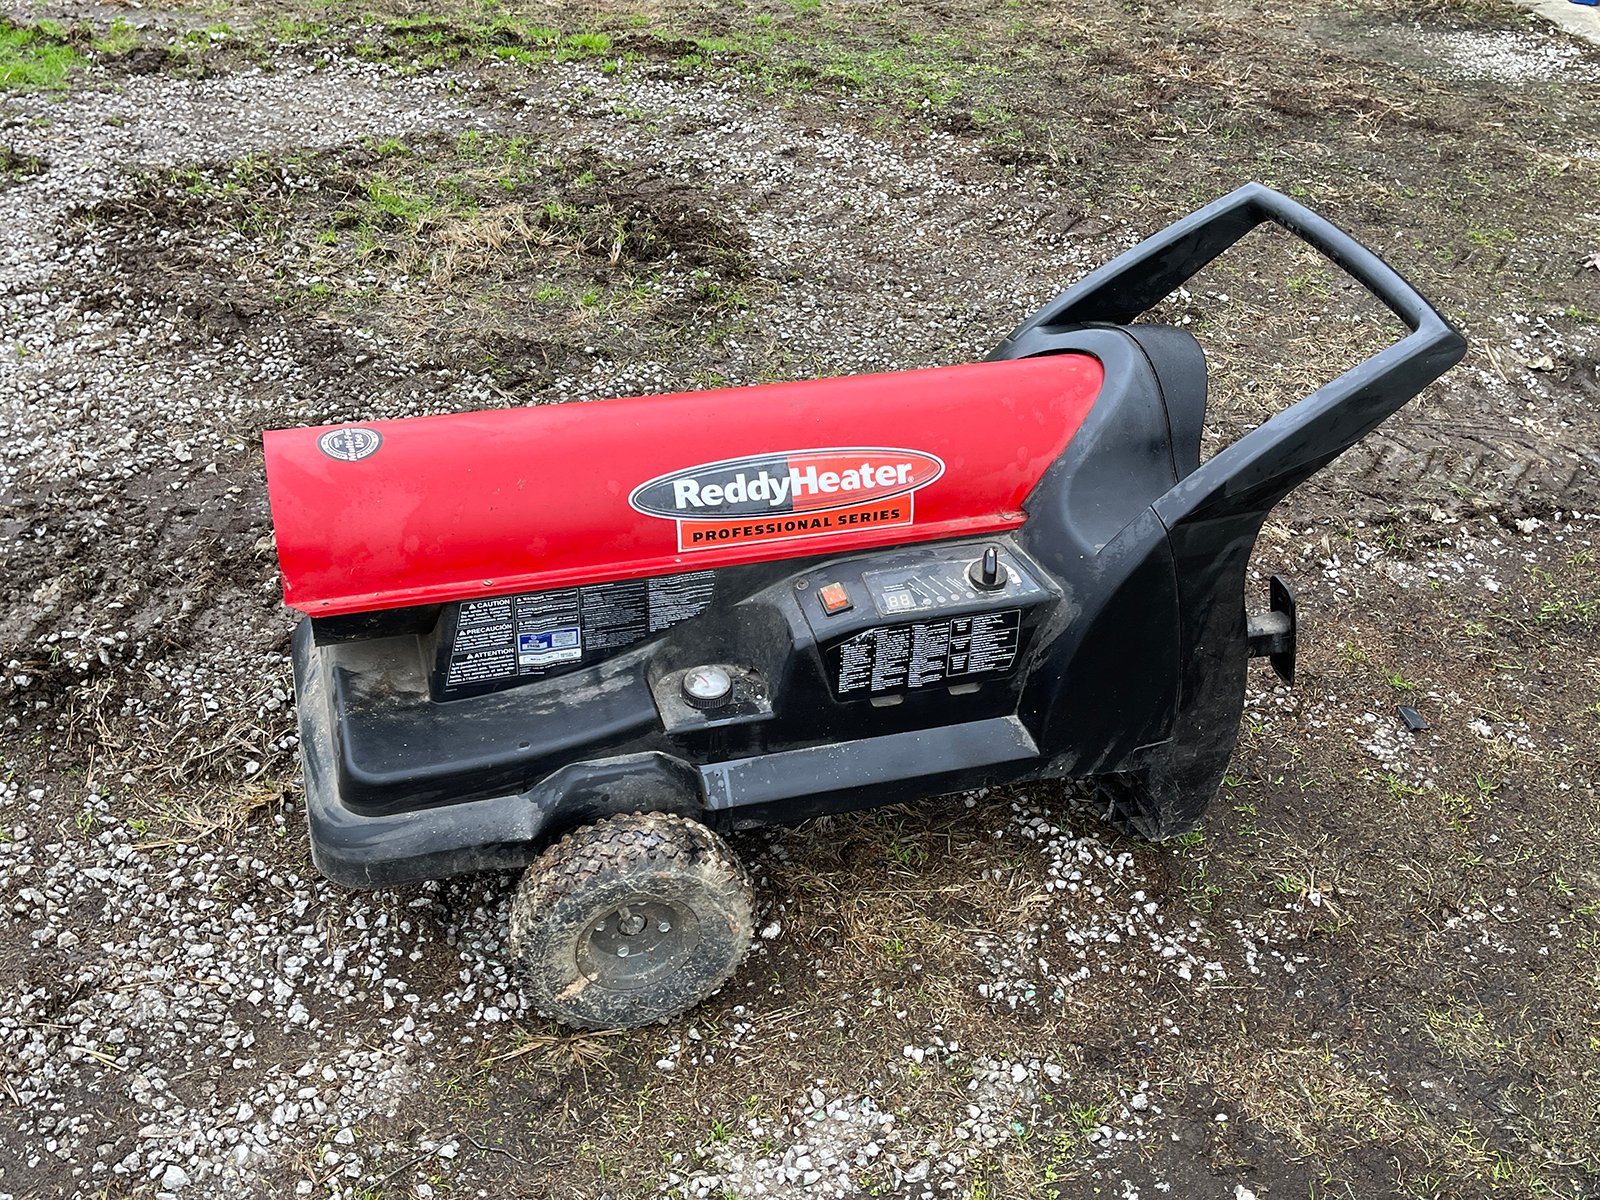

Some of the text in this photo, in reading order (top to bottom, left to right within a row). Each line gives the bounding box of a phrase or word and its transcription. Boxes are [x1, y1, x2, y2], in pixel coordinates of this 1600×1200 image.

[692, 509, 900, 543] PROFESSIONAL SERIES
[476, 599, 511, 609] CAUTION
[474, 647, 514, 659] ATTENTION
